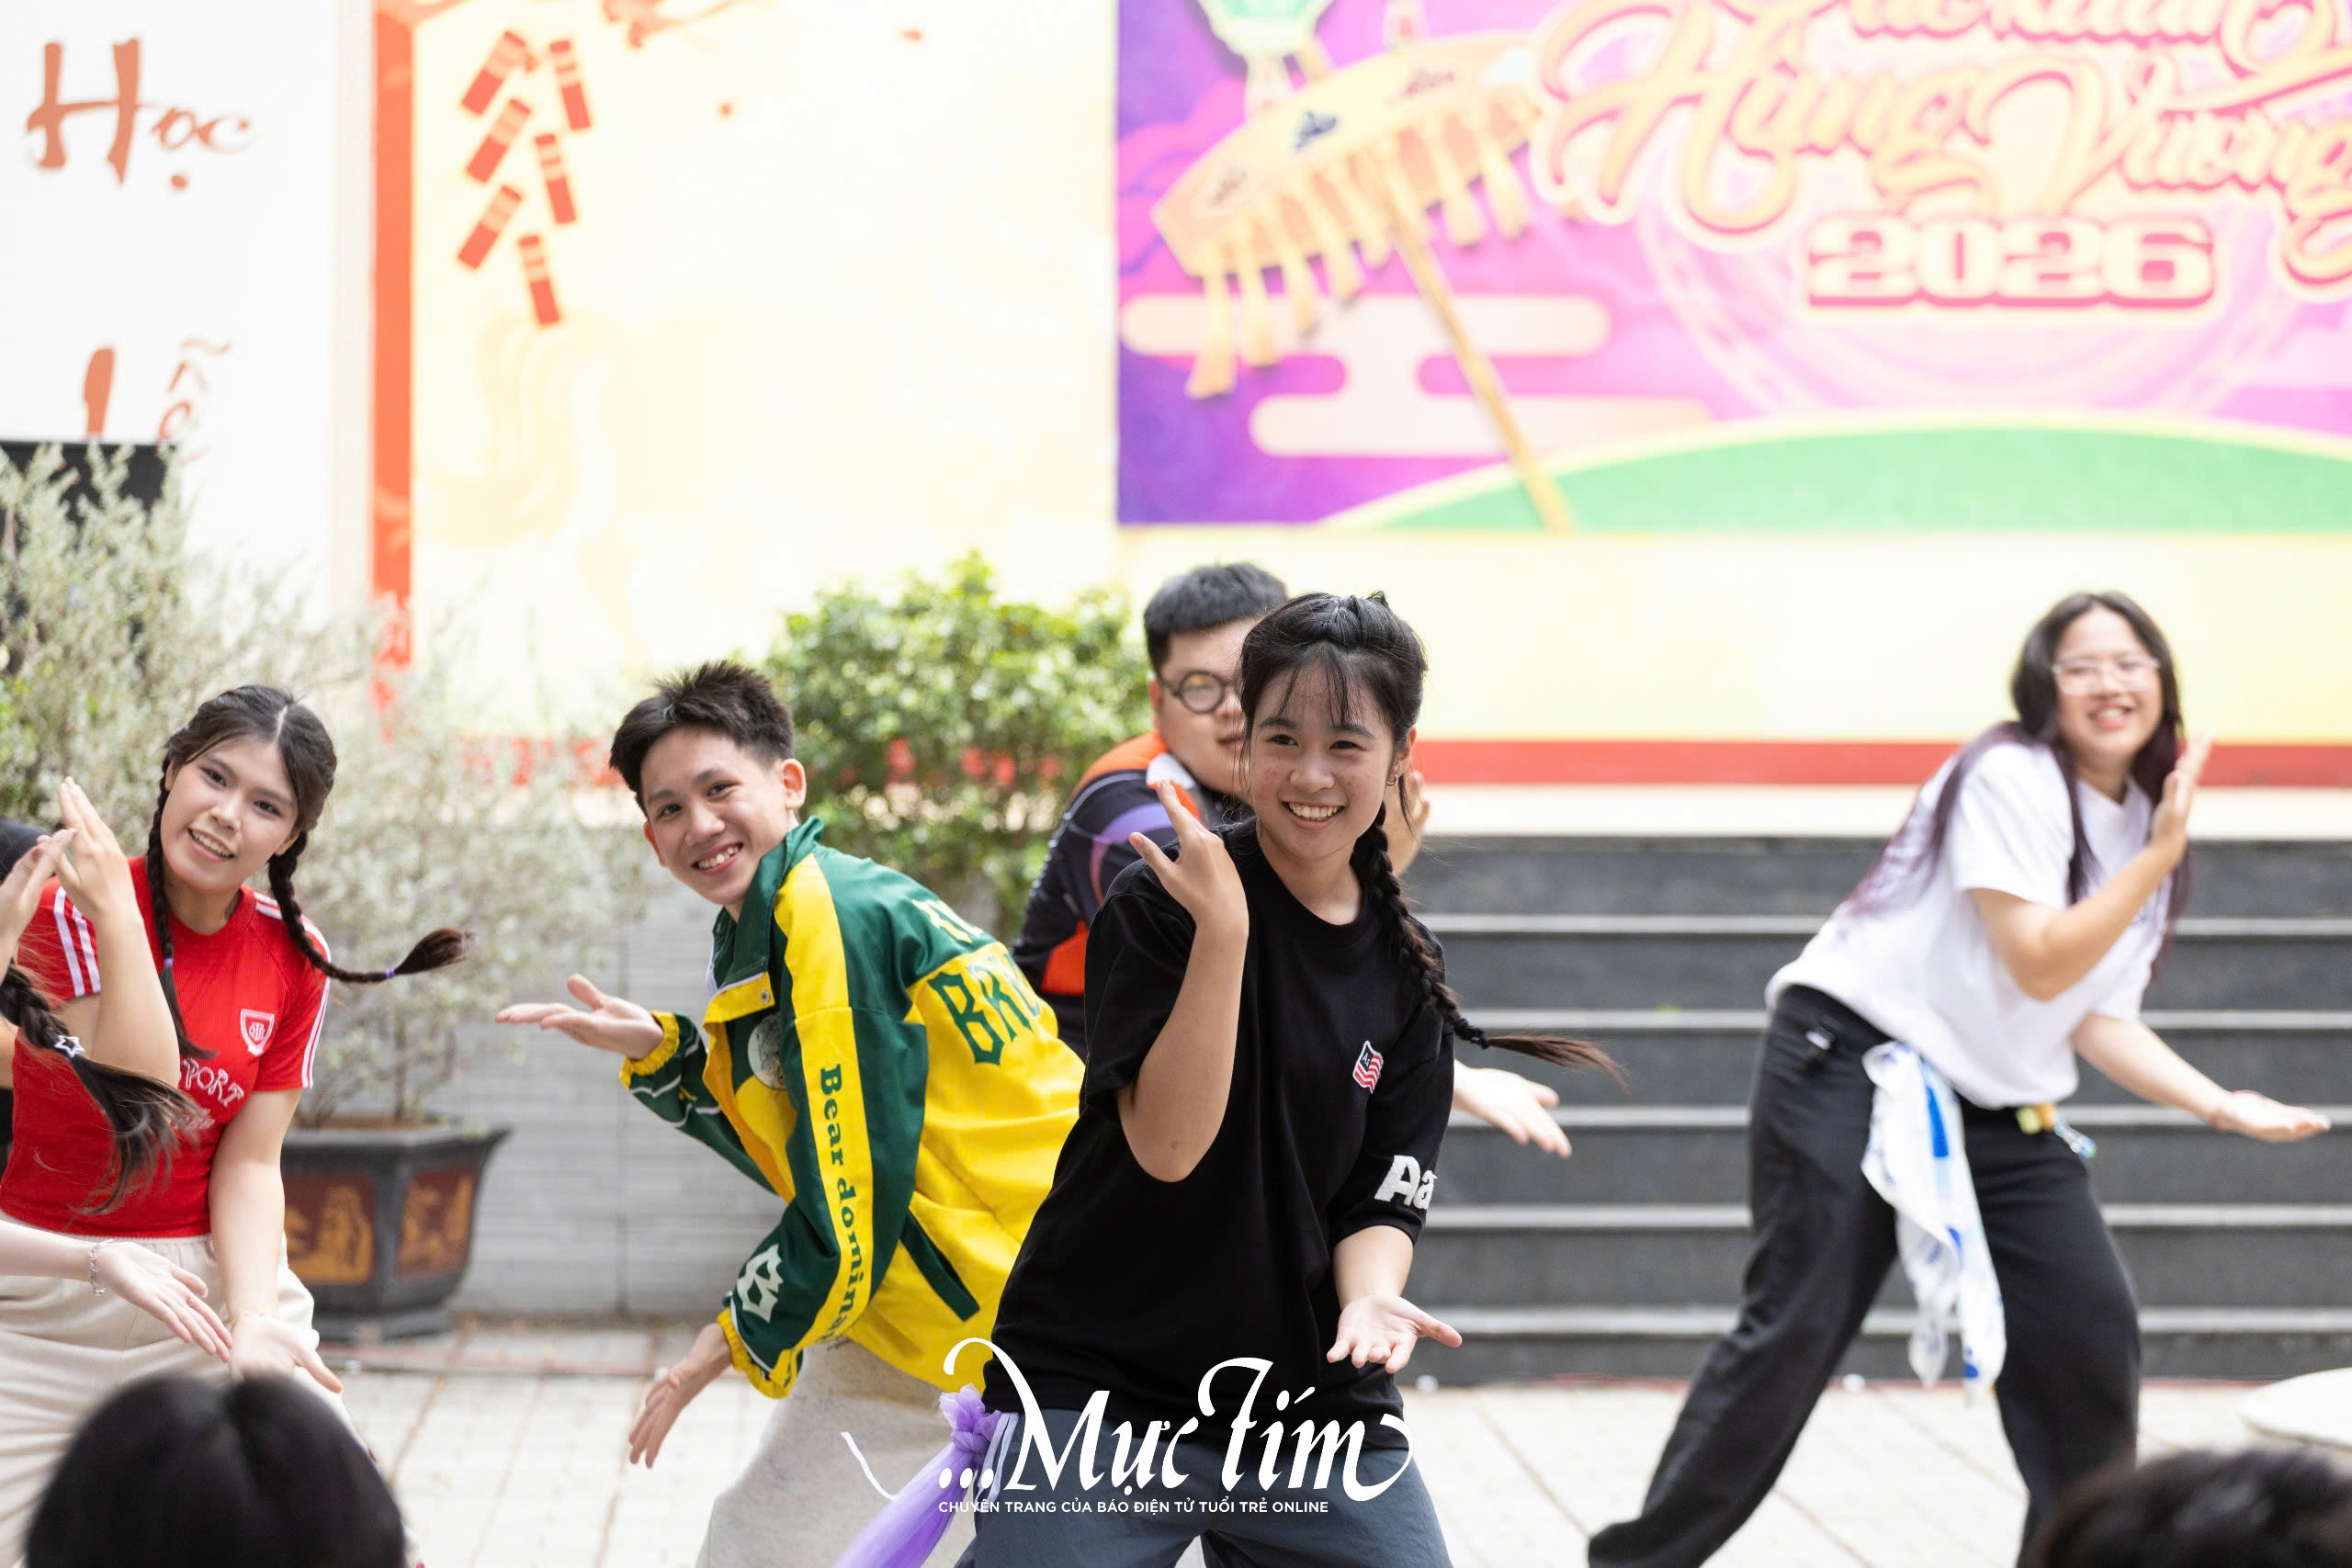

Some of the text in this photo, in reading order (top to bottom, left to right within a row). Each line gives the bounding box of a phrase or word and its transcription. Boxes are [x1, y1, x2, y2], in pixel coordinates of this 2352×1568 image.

[26, 38, 259, 189] Học
[1808, 215, 2215, 308] 2026
[178, 1057, 244, 1108] PORT
[820, 1064, 844, 1167] Bear
